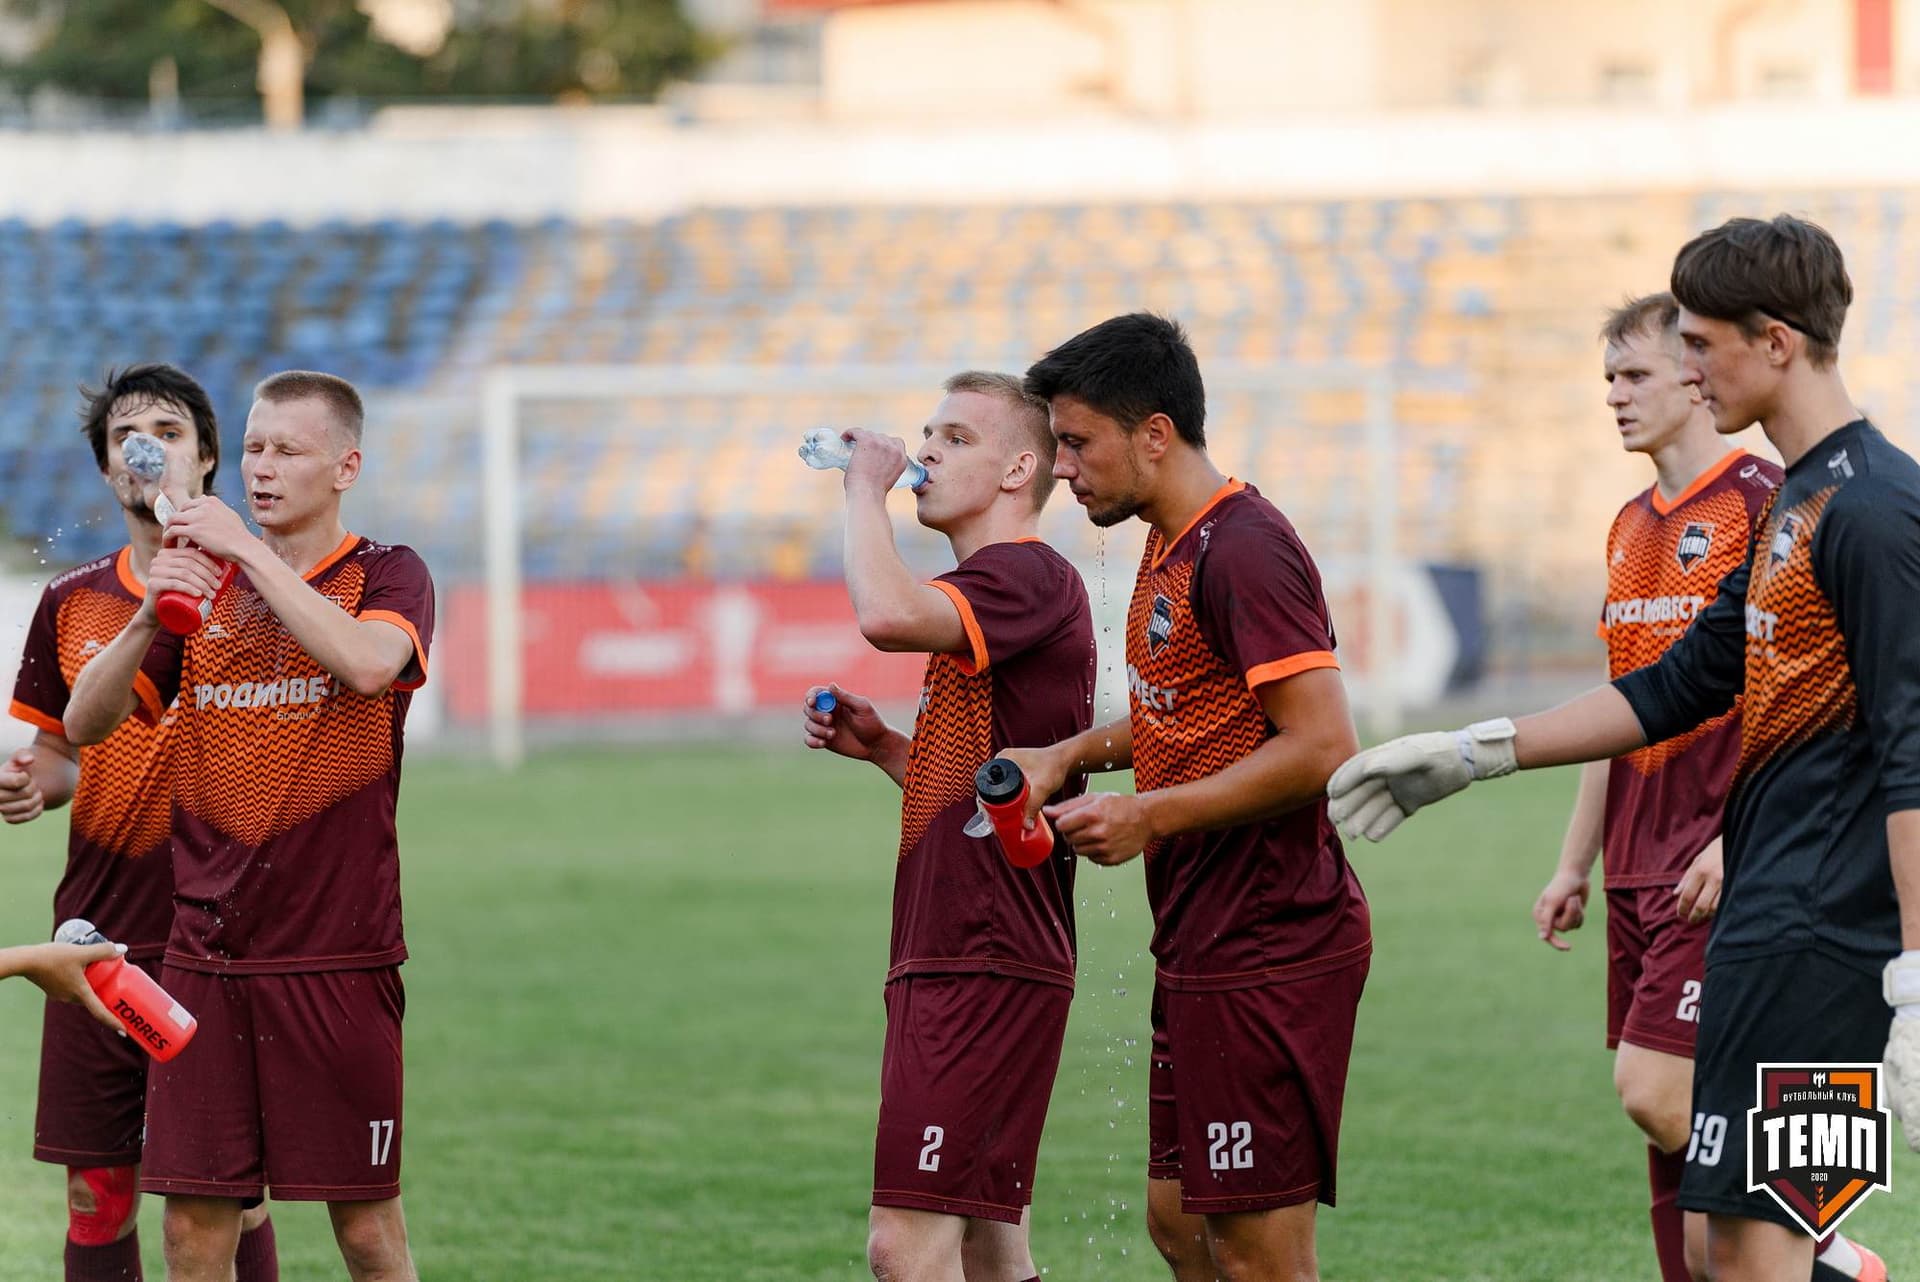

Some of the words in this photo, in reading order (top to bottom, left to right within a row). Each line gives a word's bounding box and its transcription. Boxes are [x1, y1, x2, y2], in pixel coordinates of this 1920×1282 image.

[113, 998, 168, 1051] TORRES
[1676, 979, 1702, 1024] 2
[369, 1119, 394, 1166] 17
[918, 1125, 944, 1172] 2
[1207, 1121, 1254, 1170] 22
